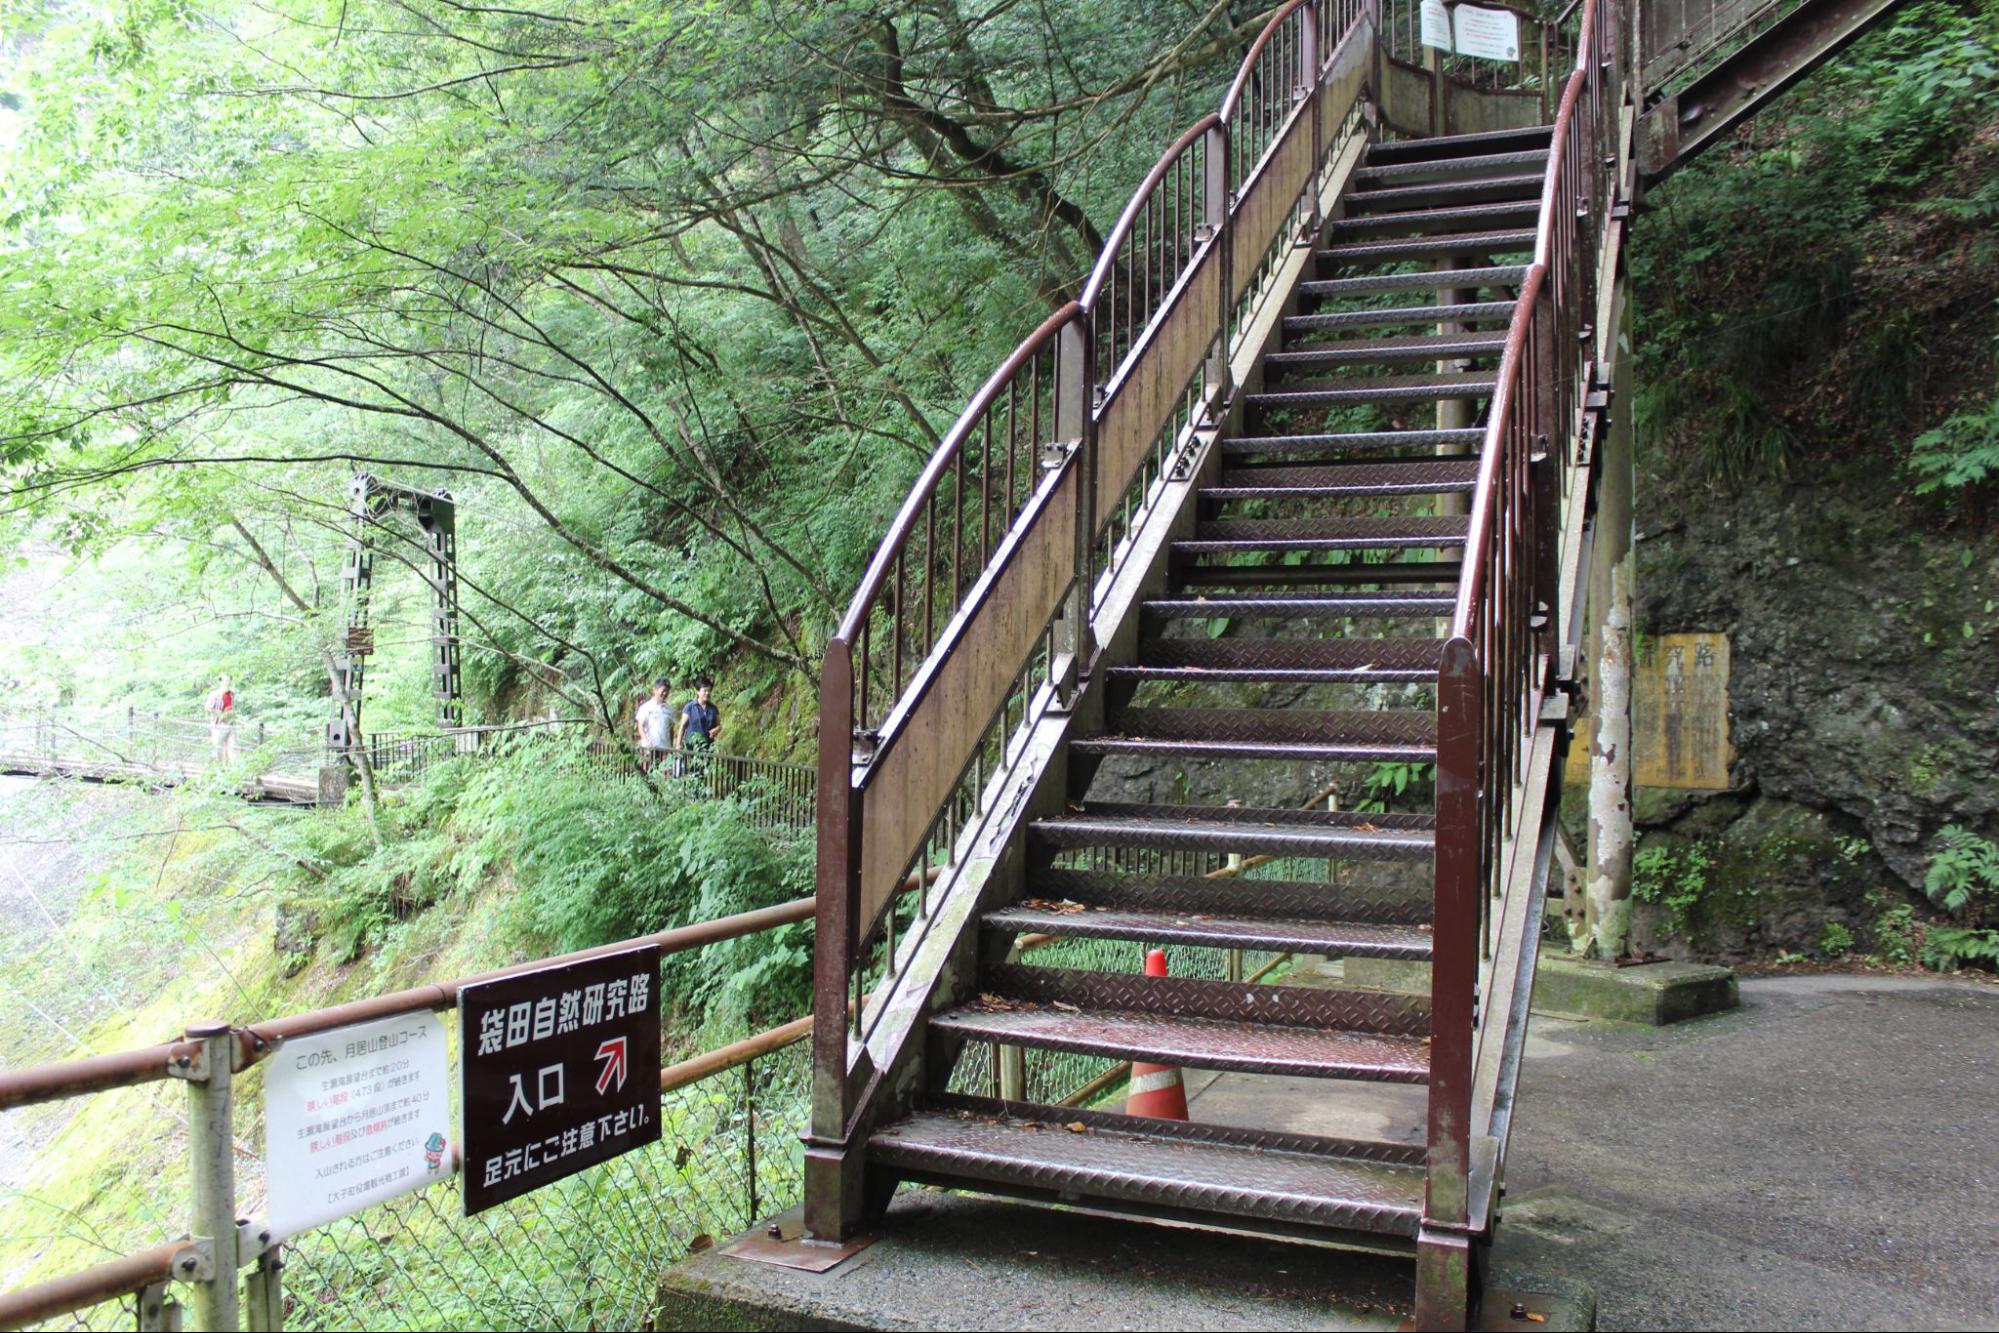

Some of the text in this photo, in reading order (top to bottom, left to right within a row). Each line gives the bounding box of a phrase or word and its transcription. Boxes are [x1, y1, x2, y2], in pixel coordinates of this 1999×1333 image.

[296, 1025, 428, 1070] この先、月居山登山コース
[477, 973, 650, 1057] 袋田自然研究路
[502, 1062, 565, 1125] 入口
[483, 1103, 650, 1188] 足元にご注意下さい。
